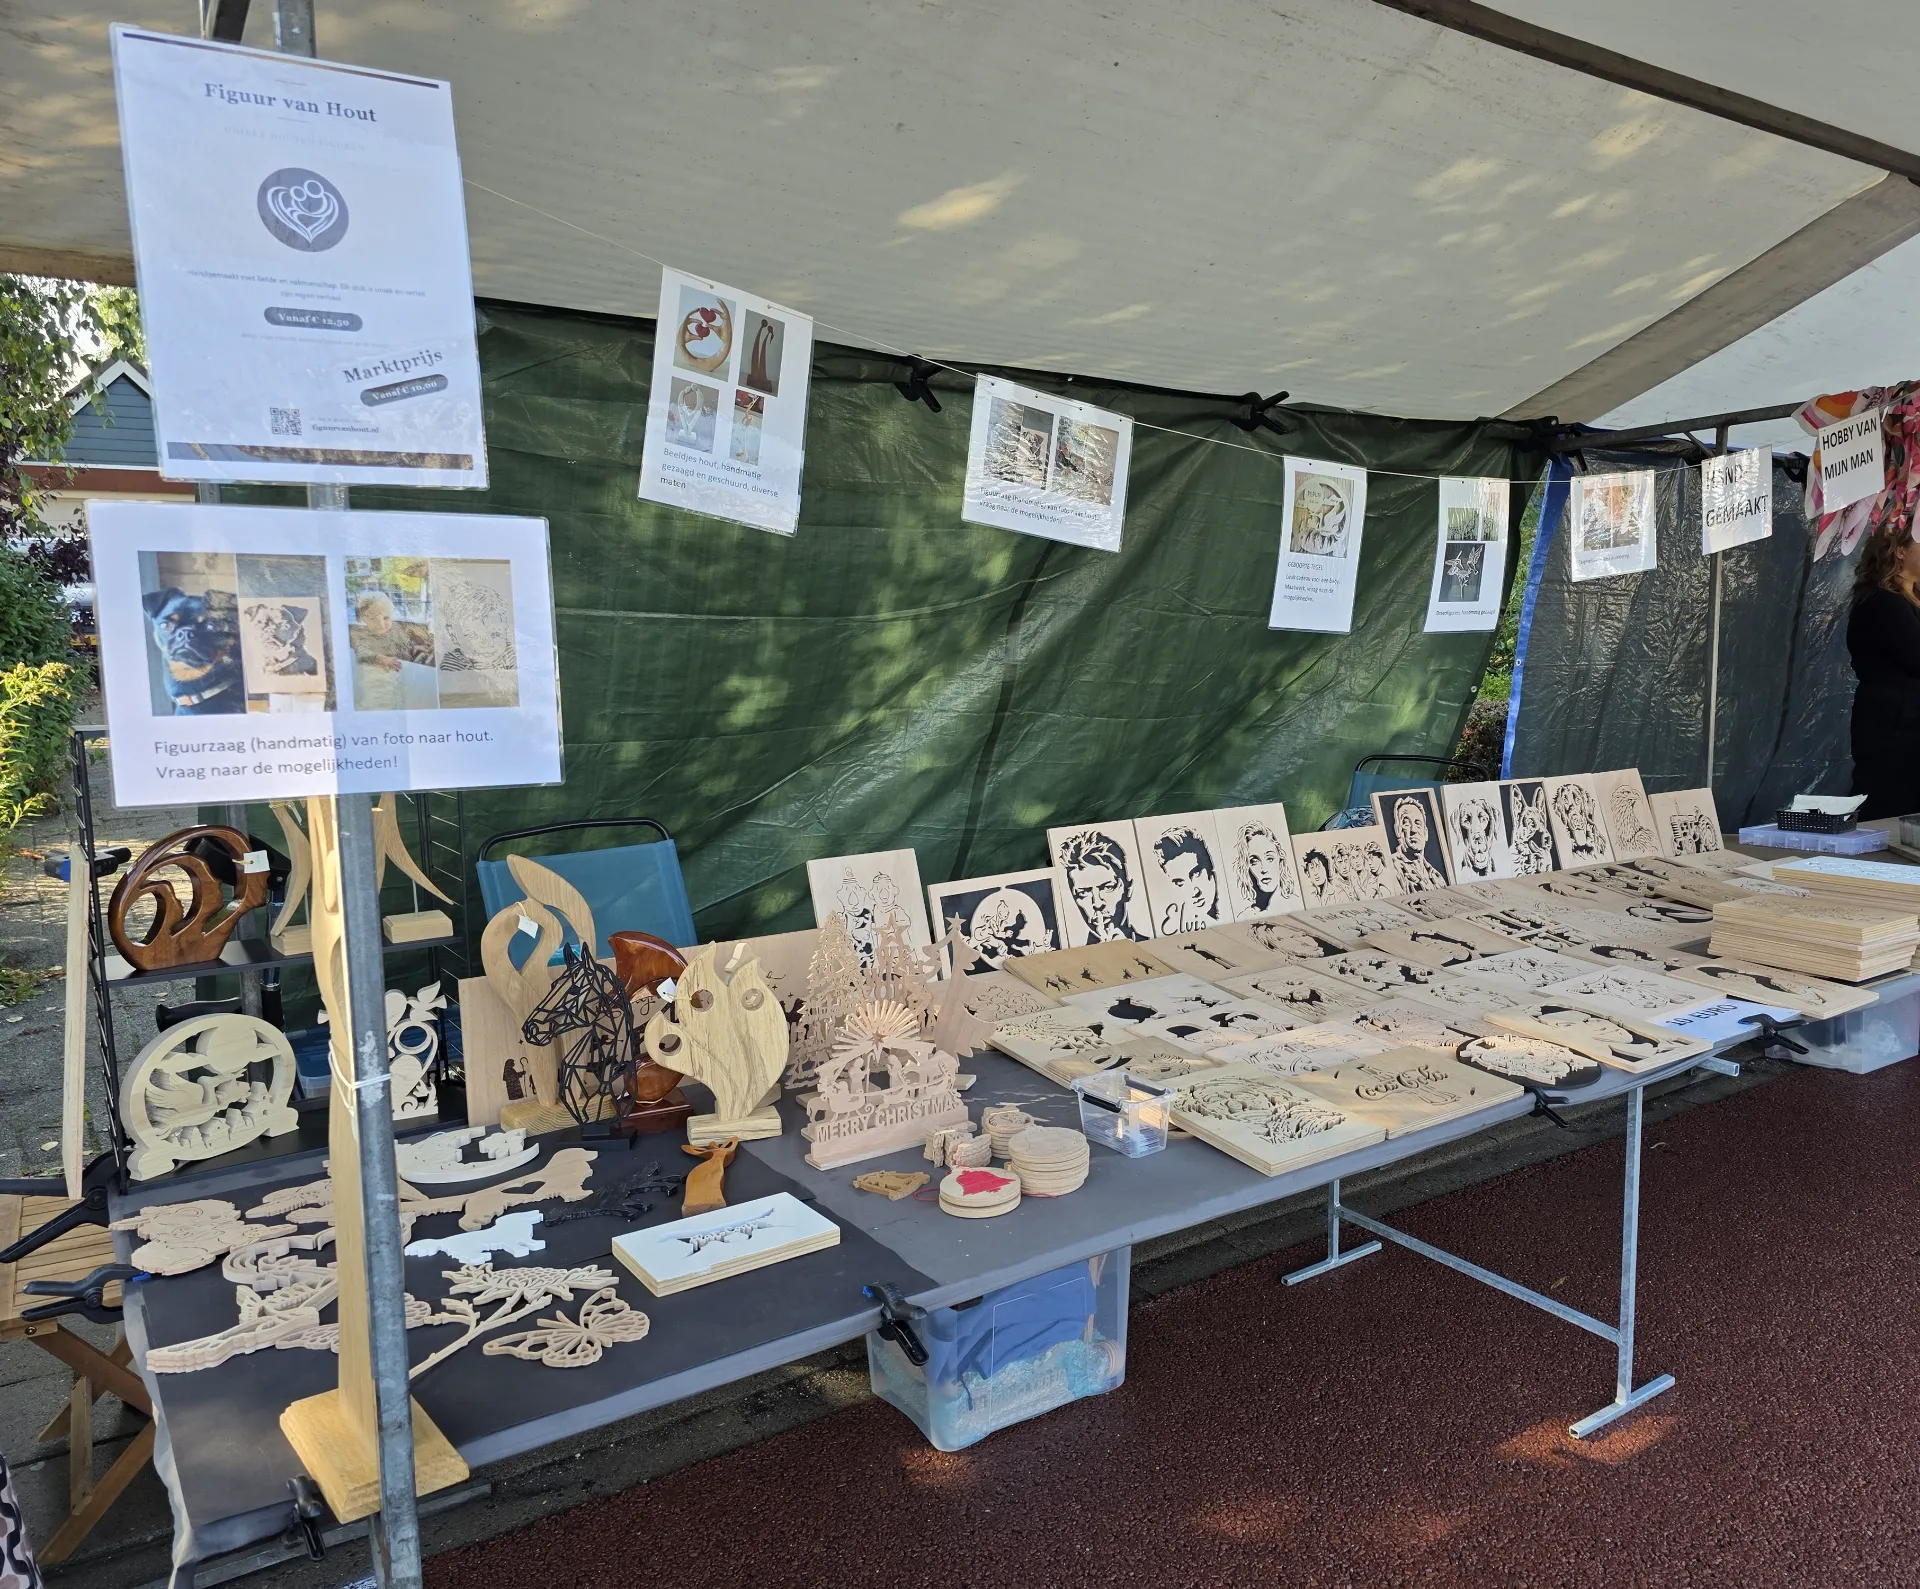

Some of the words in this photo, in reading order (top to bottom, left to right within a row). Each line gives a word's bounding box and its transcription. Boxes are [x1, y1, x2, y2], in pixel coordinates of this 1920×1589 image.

[204, 82, 277, 106] Figuur
[282, 97, 320, 114] van
[325, 101, 378, 122] Hout
[278, 313, 311, 323] Vanaf
[343, 349, 443, 384] Marktprijs
[372, 387, 401, 400] Vanaf
[311, 424, 380, 434] figuurvanhout.nl
[1822, 425, 1854, 450] HOBBY
[1856, 417, 1877, 437] VAN
[663, 447, 697, 463] Beeldjes
[698, 457, 719, 470] hout,
[721, 462, 762, 480] handmatig
[1824, 458, 1848, 480] MIJN
[1850, 449, 1873, 470] MAN
[660, 477, 686, 489] maten
[661, 463, 695, 477] gezaagd
[696, 472, 706, 480] en
[707, 475, 750, 491] geschuurd,
[751, 485, 779, 498] diverse
[1706, 495, 1768, 527] GEMAAKT
[155, 741, 246, 757] Figuurzaag
[250, 734, 347, 753] (handmatig)
[351, 735, 379, 746] van
[383, 732, 414, 744] foto
[419, 733, 452, 744] naar
[456, 730, 494, 743] hout.
[156, 765, 206, 780] Vraag
[211, 764, 248, 777] naar
[253, 761, 273, 774] de
[278, 756, 398, 775] mogelijkheden!
[1161, 901, 1206, 936] Elvis
[1666, 1017, 1694, 1026] 10
[1688, 1004, 1737, 1019] EURO
[817, 1114, 872, 1143] MERRY
[875, 1095, 962, 1127] CHRISTMAS
